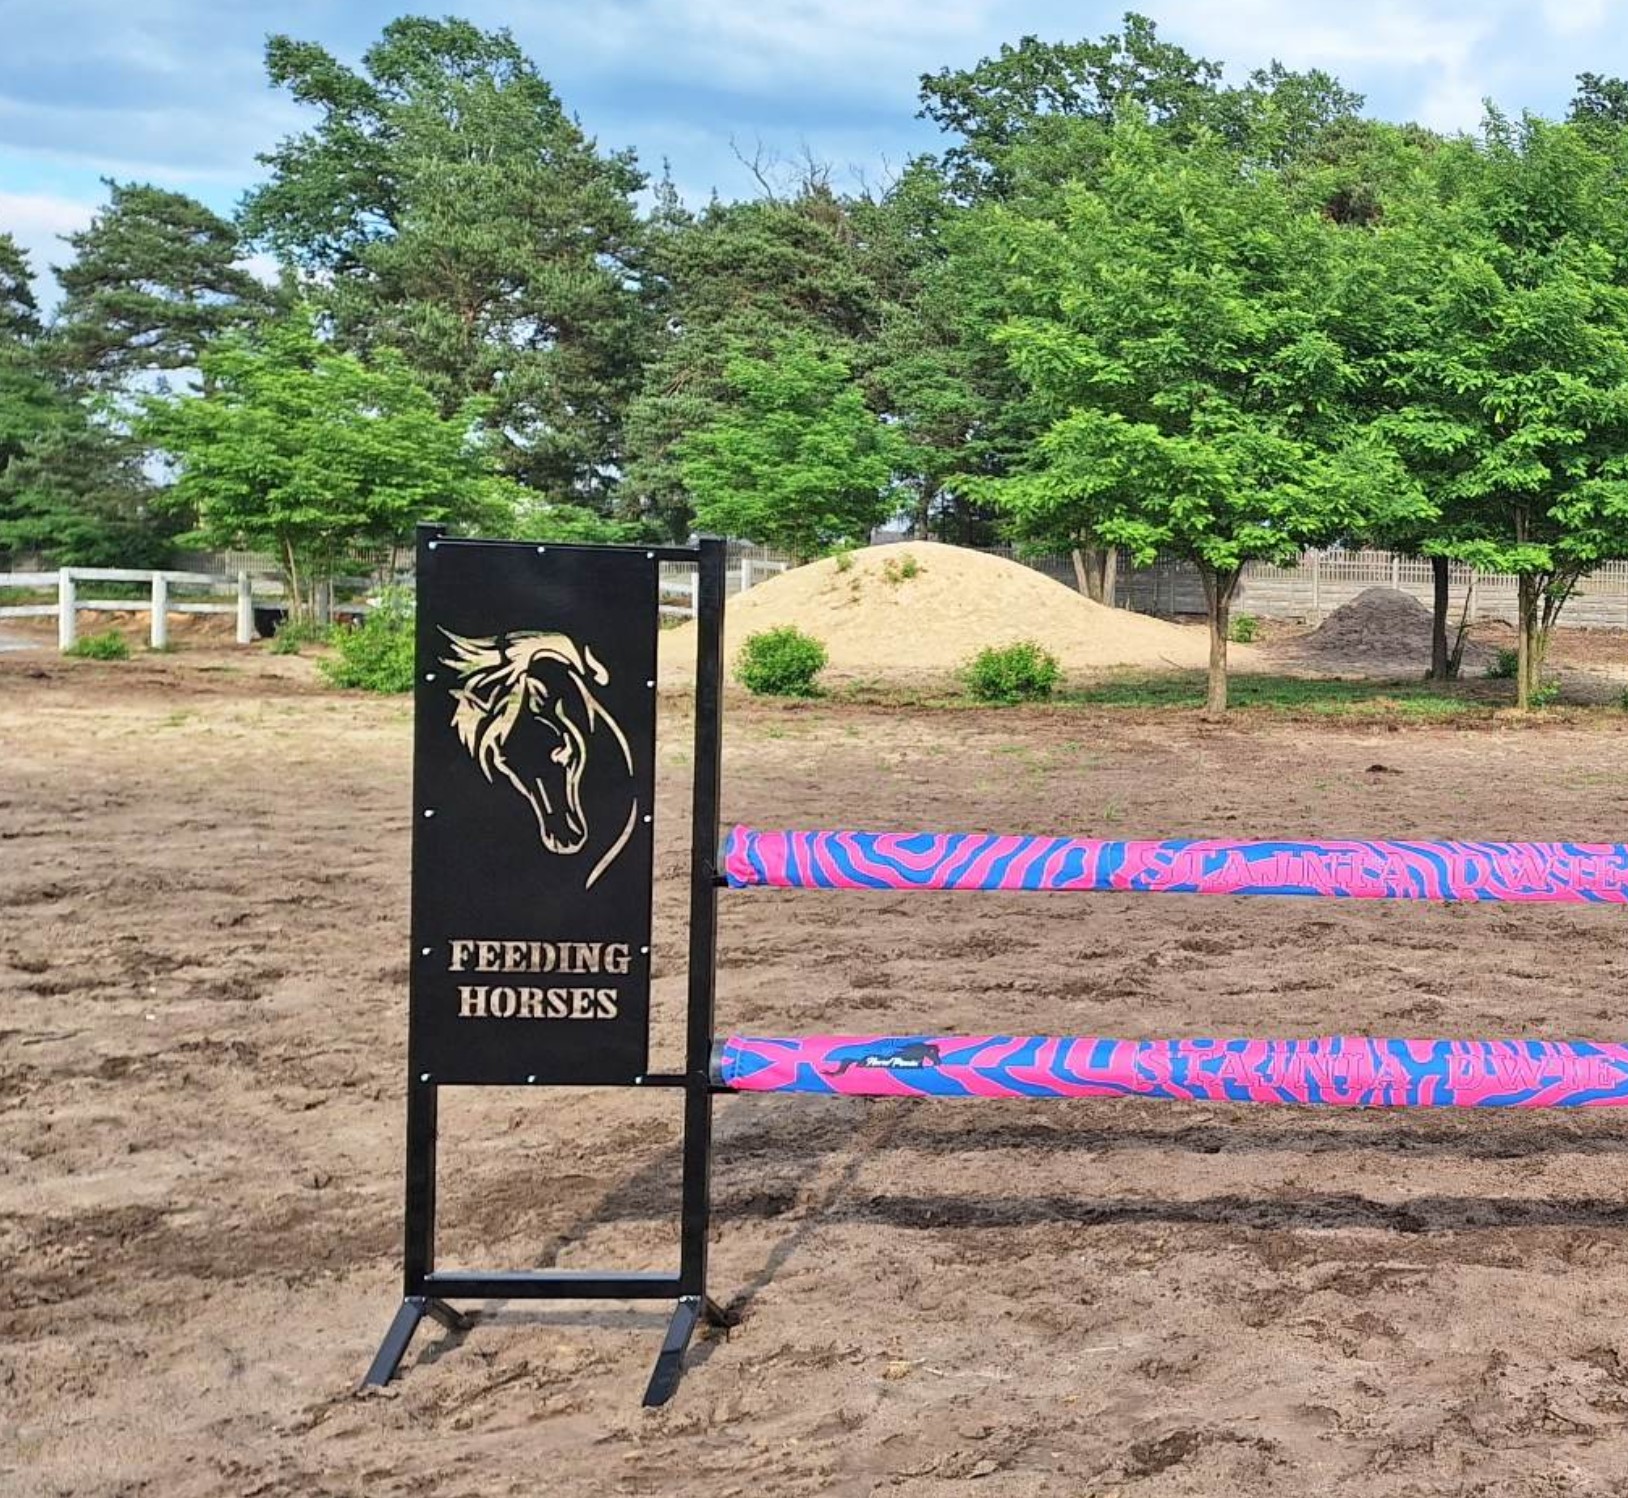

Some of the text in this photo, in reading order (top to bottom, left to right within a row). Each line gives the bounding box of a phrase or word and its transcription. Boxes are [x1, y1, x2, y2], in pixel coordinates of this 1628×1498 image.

[1140, 848, 1416, 890] STAJNIA
[448, 940, 632, 974] FEEDING
[457, 986, 618, 1019] HORSES
[1134, 1050, 1413, 1089] STAJNIA
